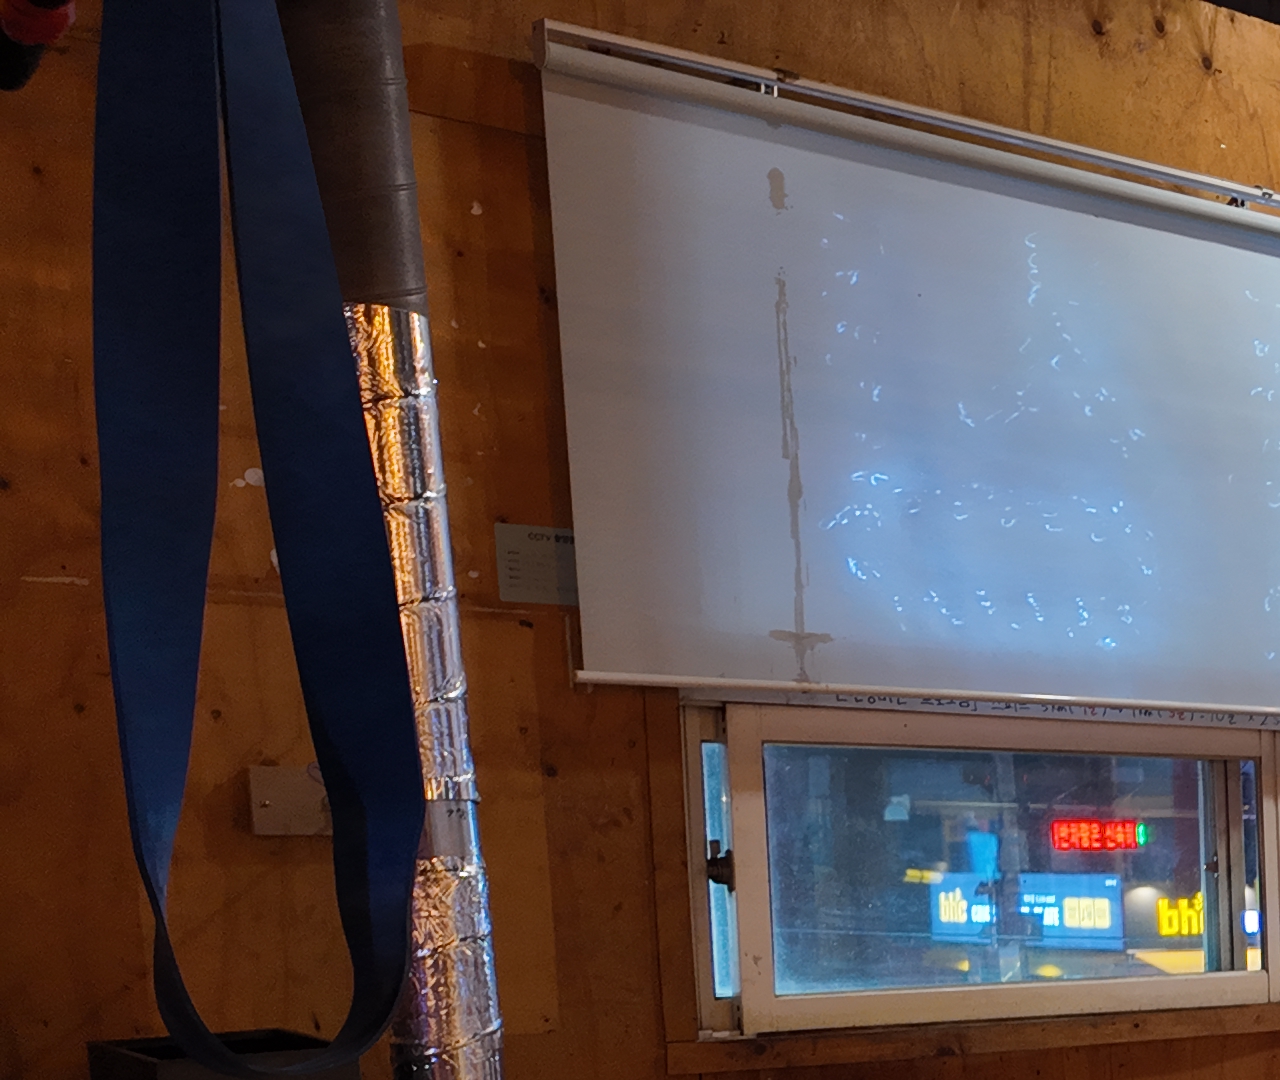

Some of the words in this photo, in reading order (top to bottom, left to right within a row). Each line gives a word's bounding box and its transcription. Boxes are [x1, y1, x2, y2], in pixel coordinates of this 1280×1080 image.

[527, 531, 552, 542] CCTV
[938, 887, 969, 924] bhc
[1157, 894, 1204, 936] bh
